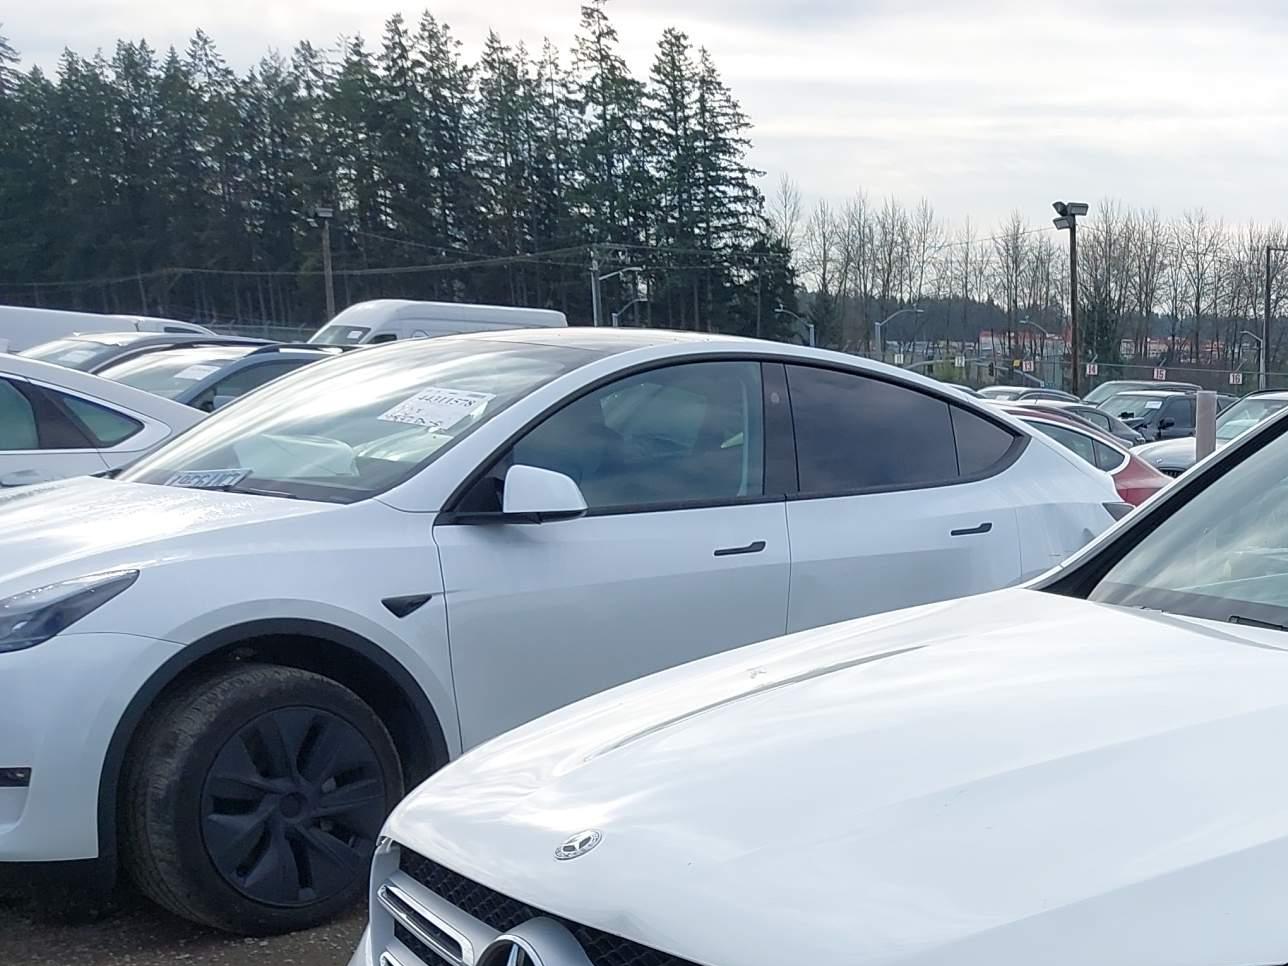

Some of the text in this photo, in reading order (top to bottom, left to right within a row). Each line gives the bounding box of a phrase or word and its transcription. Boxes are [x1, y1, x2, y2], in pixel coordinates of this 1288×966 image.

[1088, 364, 1097, 373] 14
[1155, 368, 1164, 378] 15
[1232, 374, 1241, 384] 16
